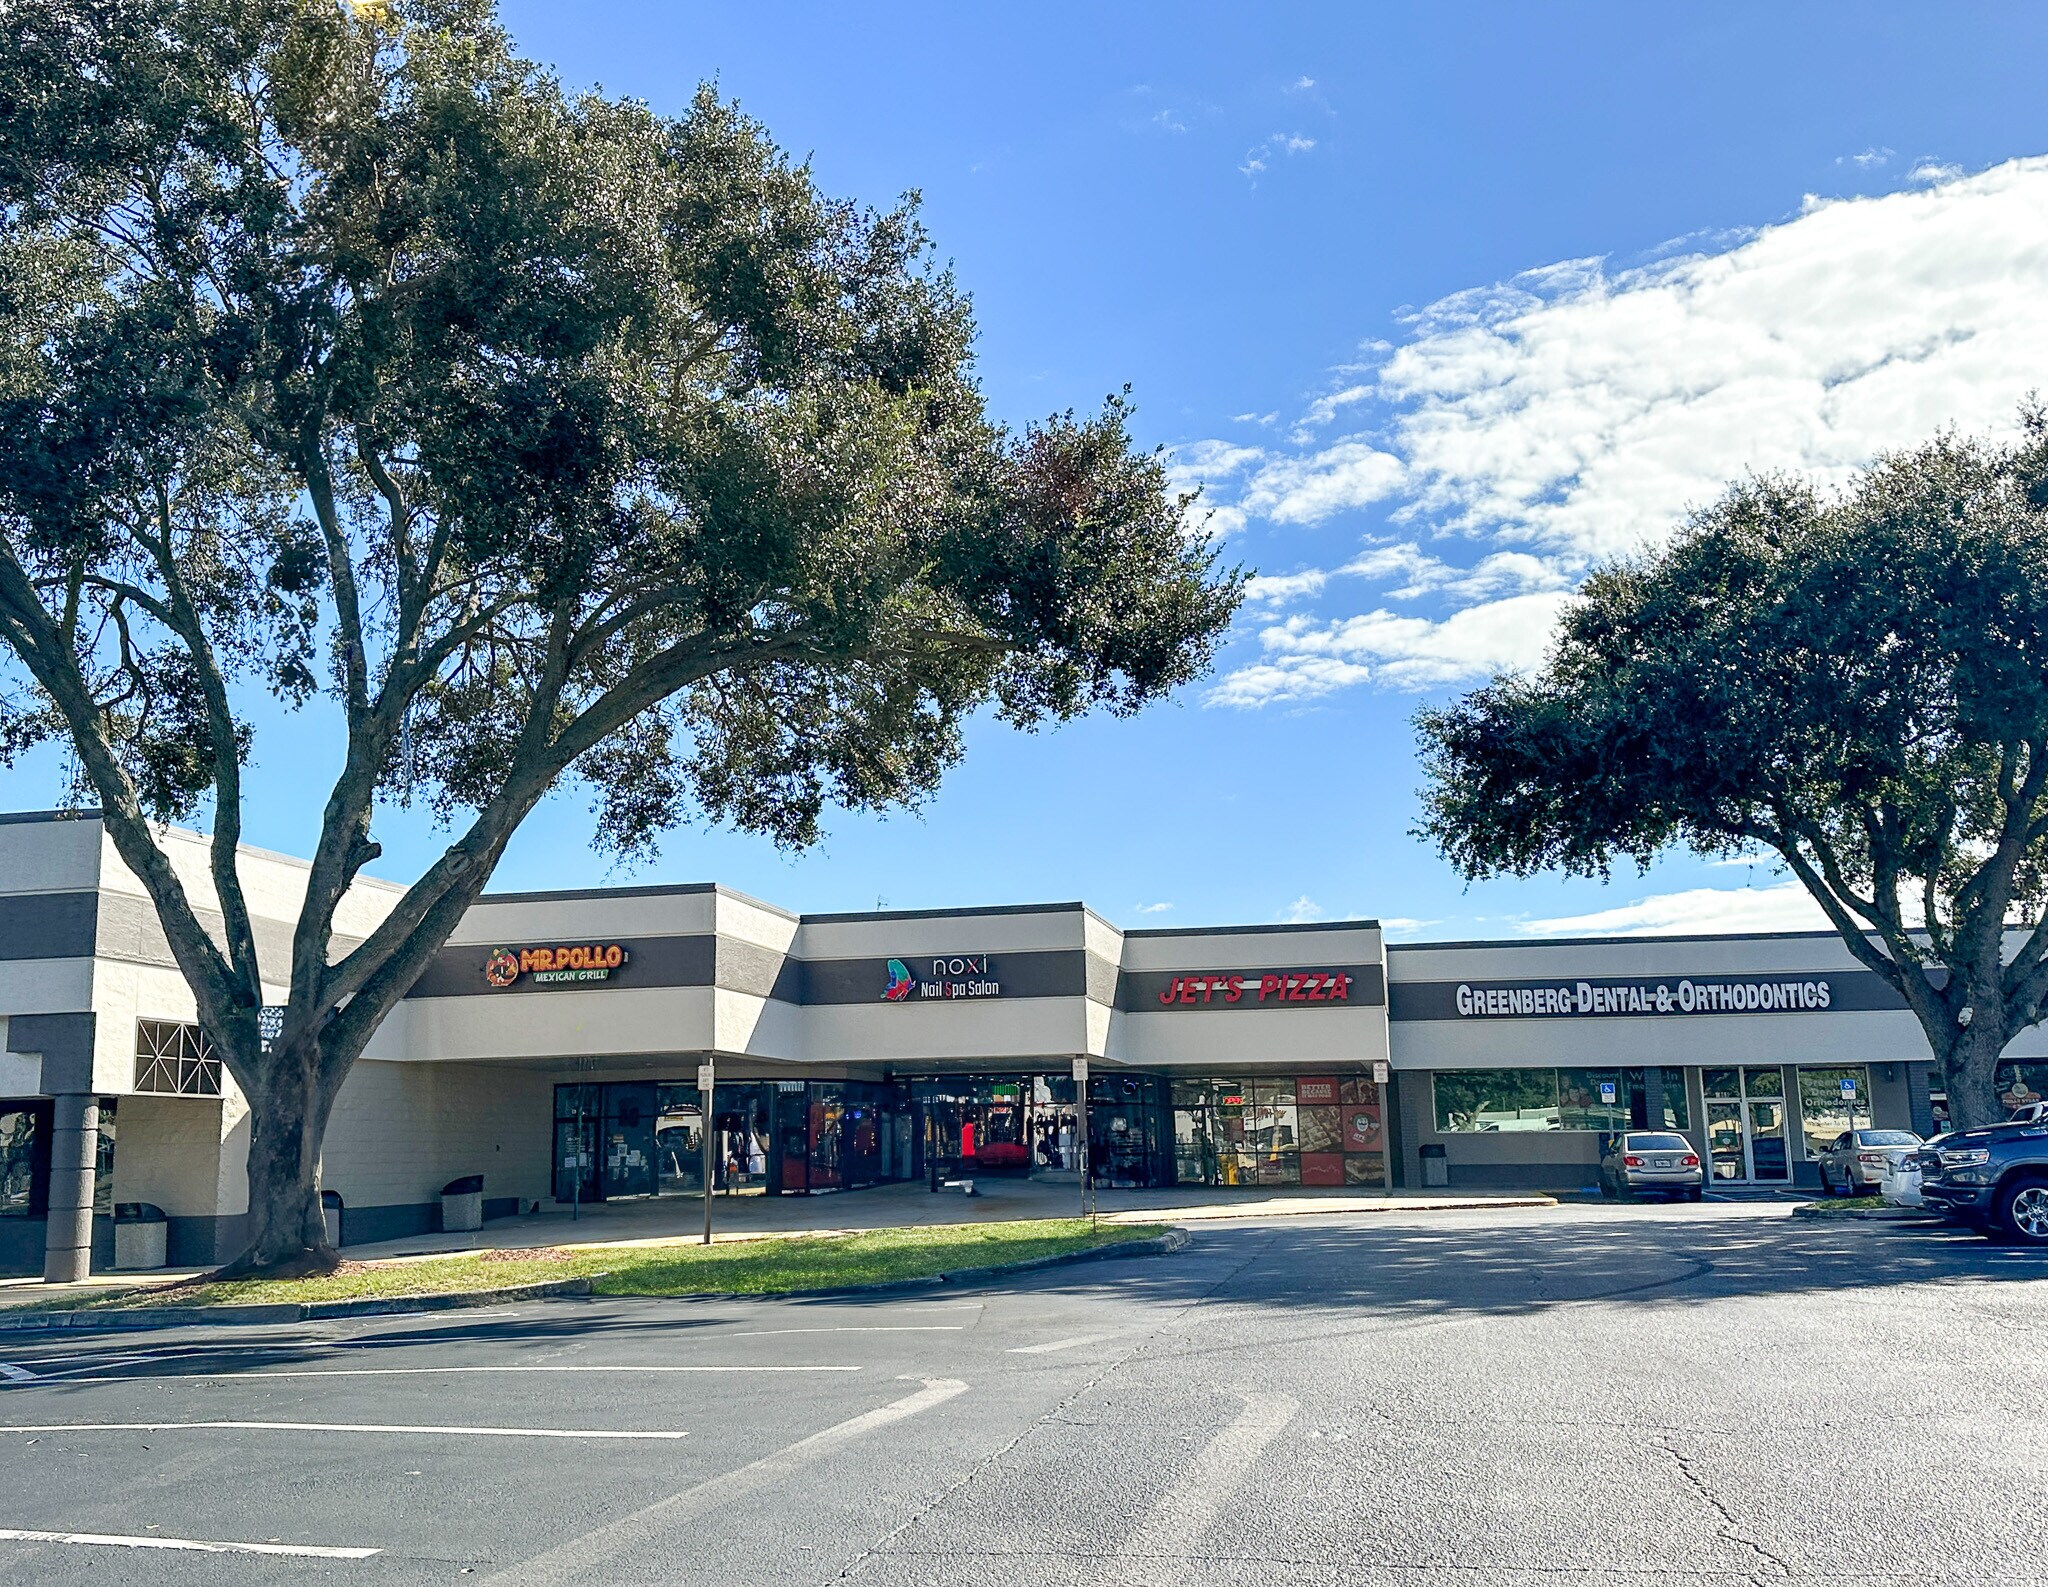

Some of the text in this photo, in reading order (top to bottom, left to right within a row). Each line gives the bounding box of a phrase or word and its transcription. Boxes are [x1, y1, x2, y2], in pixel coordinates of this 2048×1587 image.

[933, 953, 987, 975] noxi
[535, 970, 606, 983] MEXICAN GRILL
[921, 979, 999, 998] Nail Spa Salon
[1159, 973, 1348, 1004] JET'S PIZZA
[1456, 980, 1831, 1015] GREENBERG DENTAL & ORTHODONTICS
